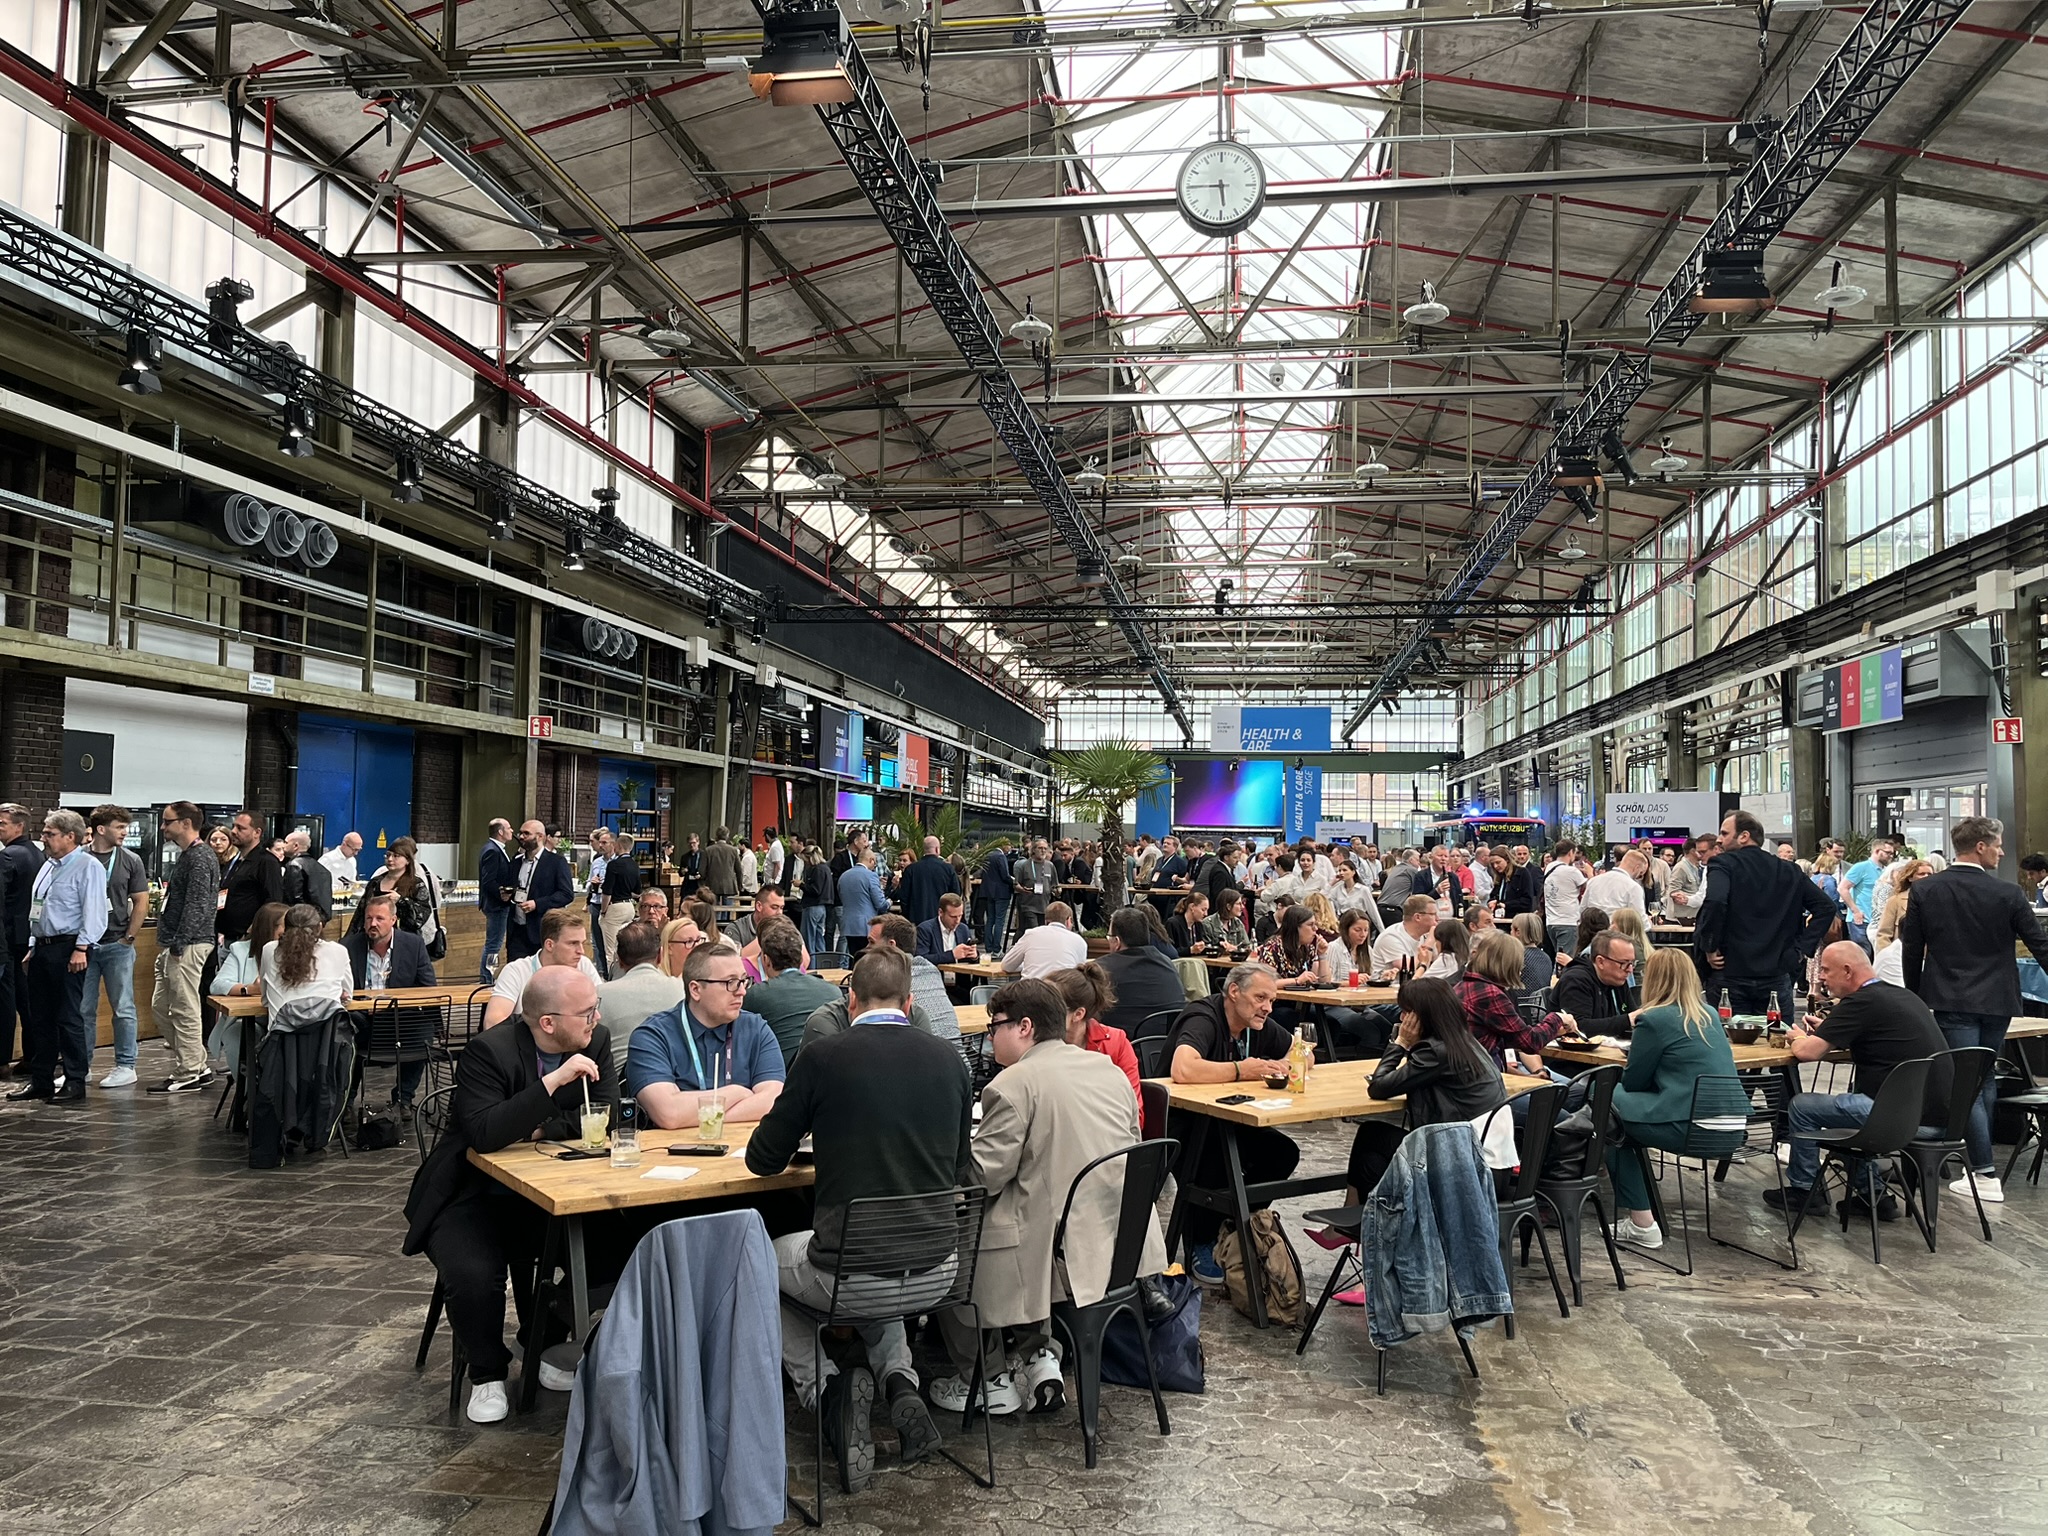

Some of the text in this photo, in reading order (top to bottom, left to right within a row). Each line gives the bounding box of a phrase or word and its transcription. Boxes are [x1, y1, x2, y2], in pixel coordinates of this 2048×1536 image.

[1242, 728, 1289, 740] HEALTH
[1292, 728, 1302, 740] &
[1240, 740, 1273, 751] CARE
[1295, 770, 1304, 791] CARE
[1304, 770, 1313, 795] STAGE
[1615, 802, 1669, 814] SCHÖN, DASS
[1295, 801, 1304, 832] HEALTH
[1615, 815, 1665, 825] SIE DA SIND!
